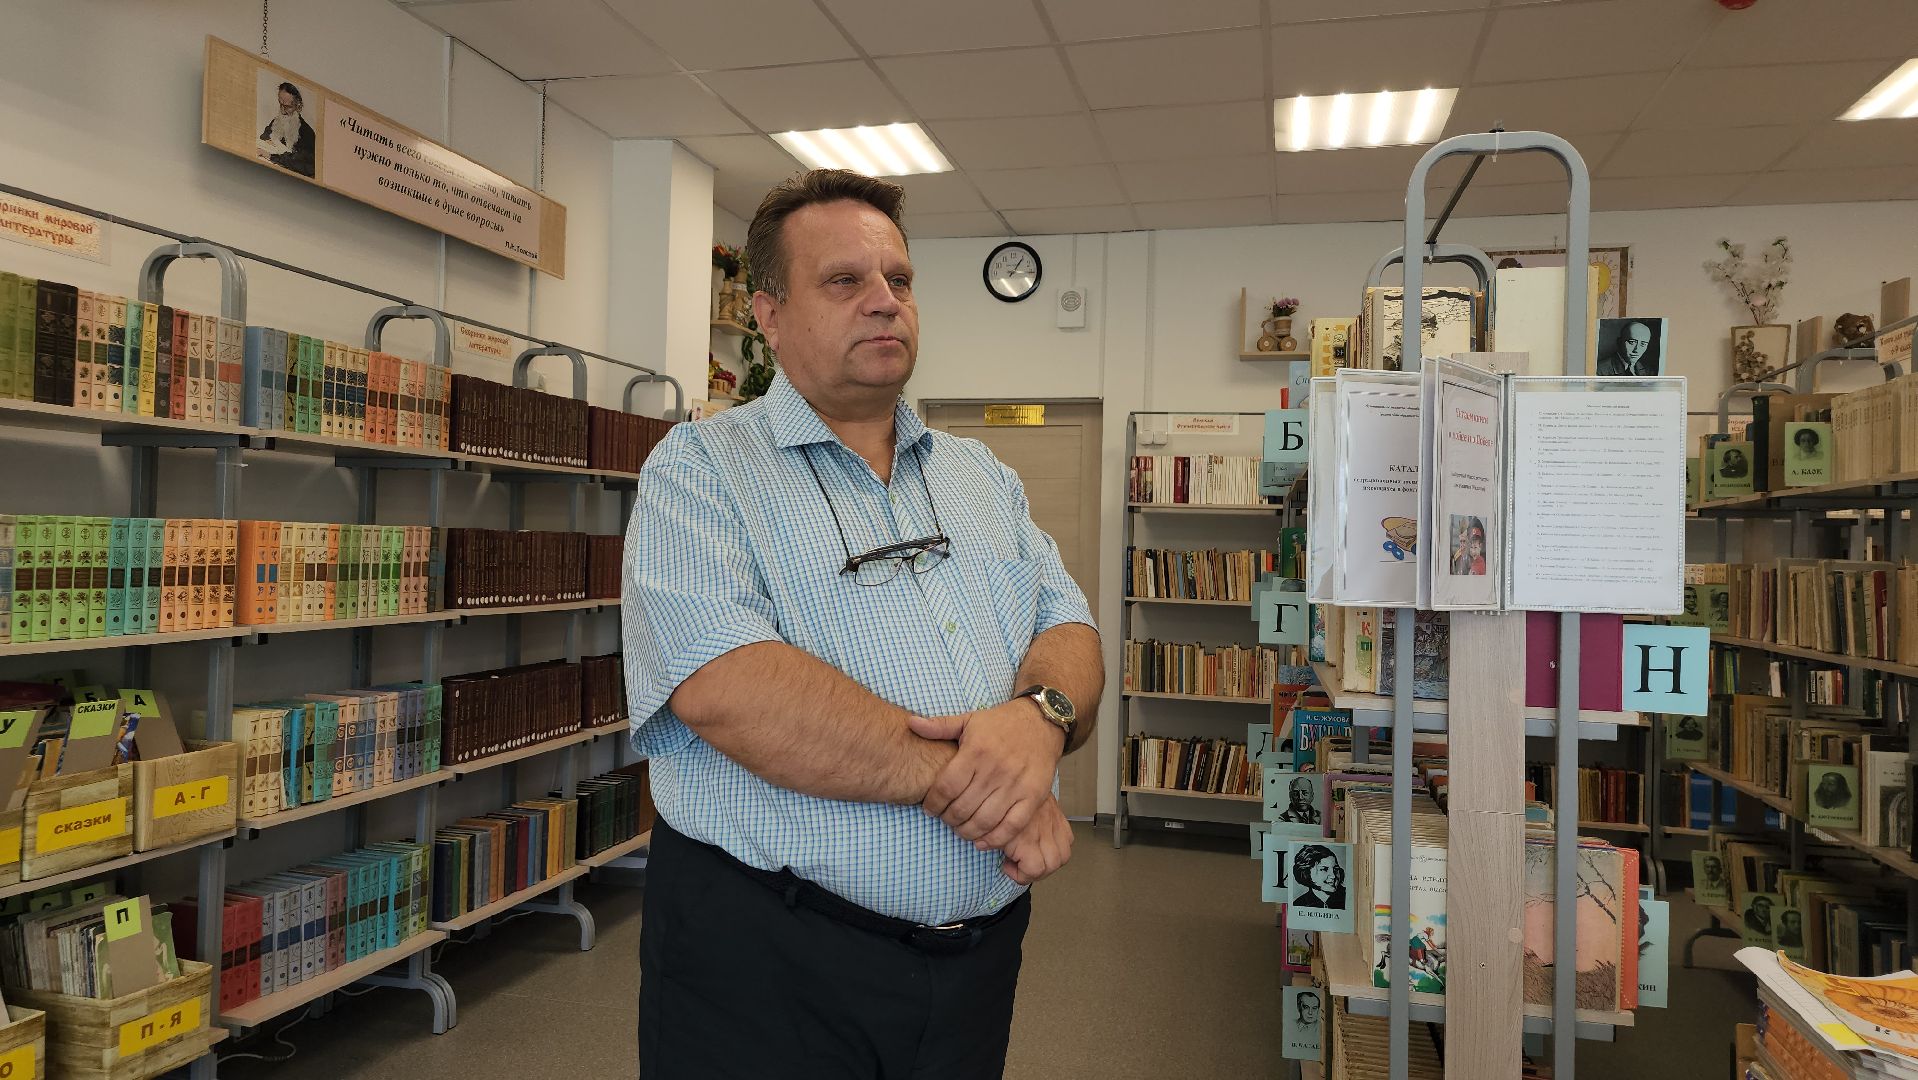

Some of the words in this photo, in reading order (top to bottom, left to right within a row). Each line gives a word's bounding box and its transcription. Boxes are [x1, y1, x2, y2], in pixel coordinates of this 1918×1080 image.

[340, 117, 394, 149] «Читать
[397, 143, 422, 161] всего
[502, 189, 532, 211] читать
[353, 145, 391, 168] нужно
[393, 162, 431, 184] только
[432, 178, 449, 194] то,
[451, 186, 469, 200] что
[470, 195, 511, 220] отвечает
[512, 213, 522, 224] на
[0, 202, 39, 220] рники
[44, 214, 94, 235] мировой
[378, 176, 433, 205] возникшие
[434, 198, 440, 208] в
[442, 199, 465, 218] душе
[466, 211, 505, 233] вопросы»
[1278, 421, 1304, 451] Б
[1273, 603, 1299, 633] Г
[1633, 644, 1690, 695] Н
[77, 703, 116, 714] СКАЗКИ
[134, 694, 147, 706] А
[174, 791, 187, 806] А
[201, 785, 211, 800] Г
[54, 813, 112, 836] сказки
[116, 907, 129, 925] П
[1638, 983, 1656, 992] кин
[140, 1022, 153, 1039] П
[170, 1010, 182, 1028] Я
